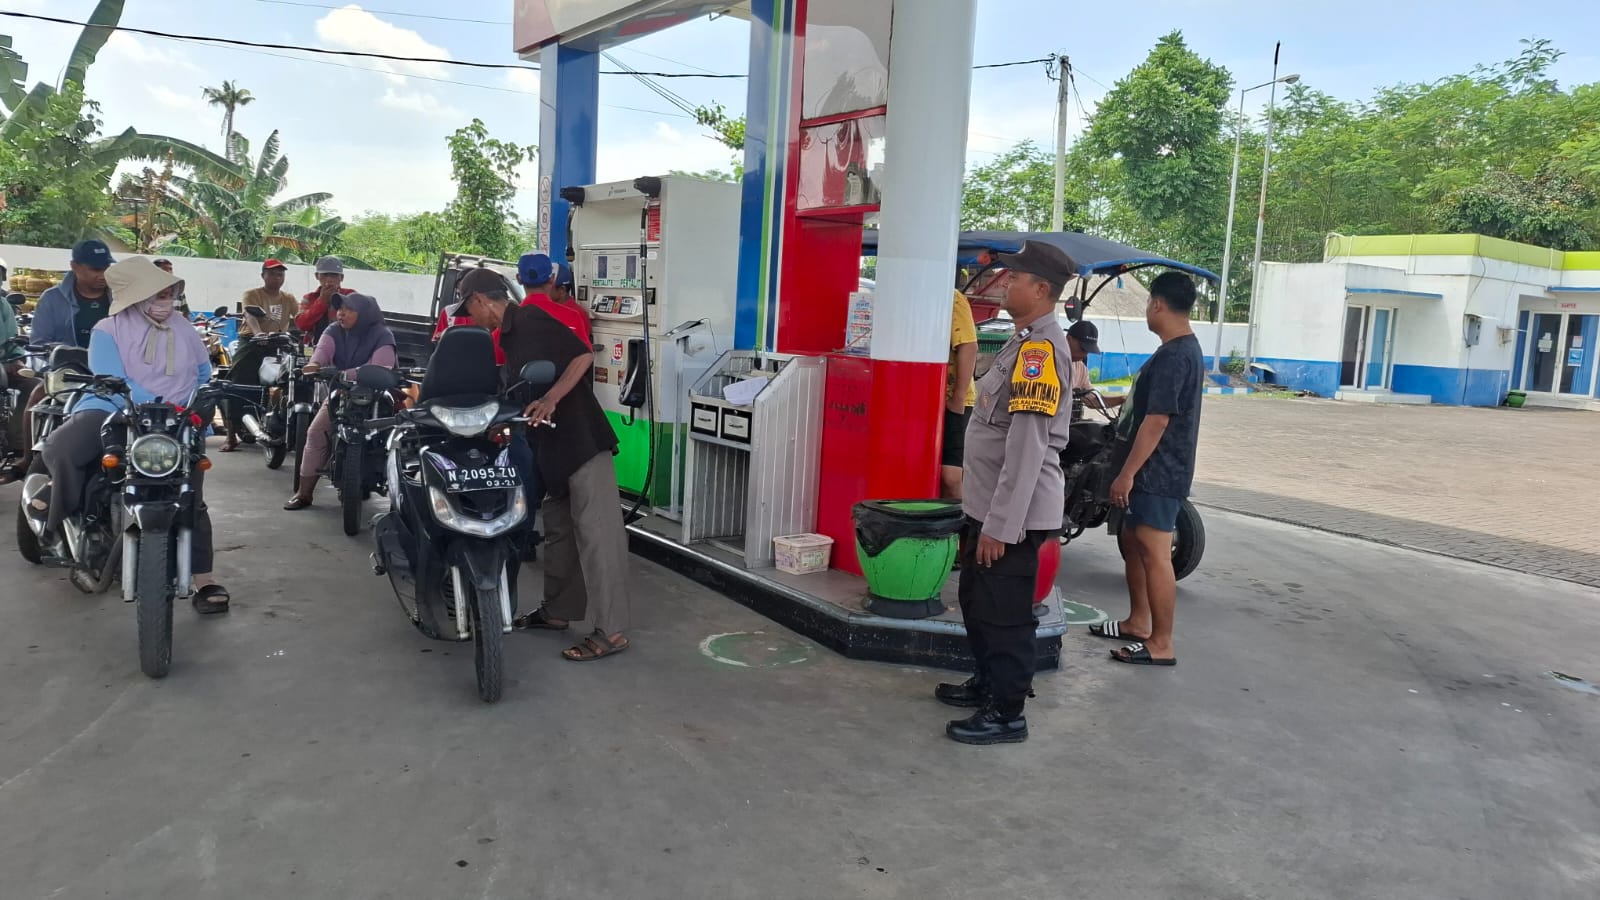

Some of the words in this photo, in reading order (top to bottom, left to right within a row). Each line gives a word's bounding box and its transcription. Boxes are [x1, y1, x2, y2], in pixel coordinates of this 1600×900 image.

[592, 279, 613, 287] PERTALITE
[620, 279, 643, 288] PERTALIT
[448, 470, 457, 481] N
[461, 467, 495, 480] 2095
[499, 467, 516, 478] ZU
